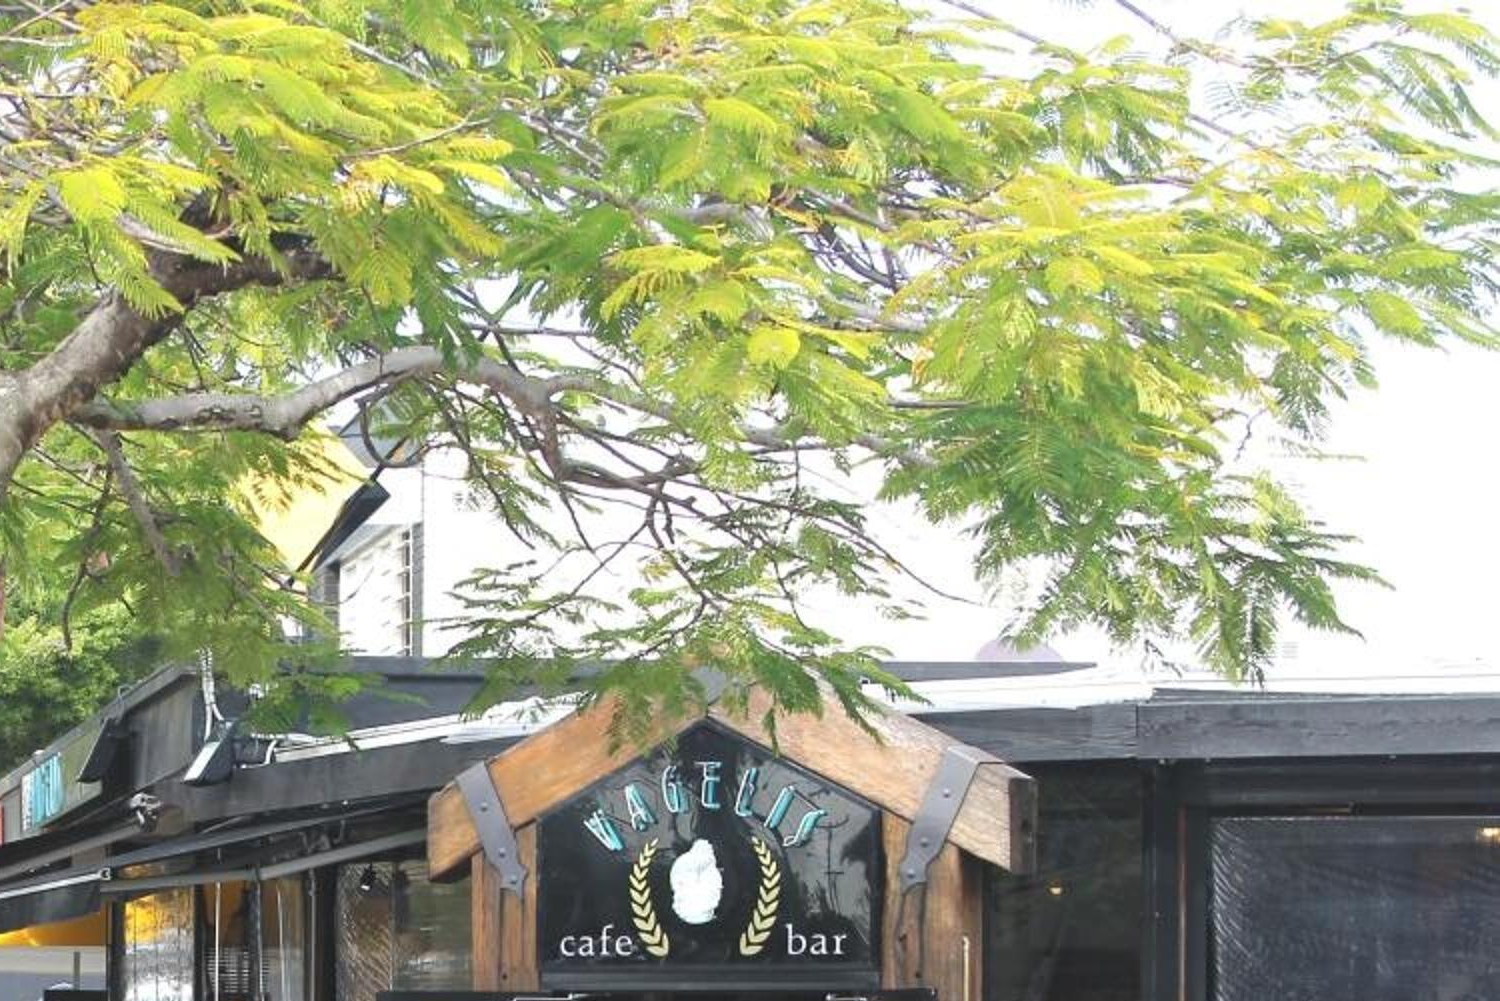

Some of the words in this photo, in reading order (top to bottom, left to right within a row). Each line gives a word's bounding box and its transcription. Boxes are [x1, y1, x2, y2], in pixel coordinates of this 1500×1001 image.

[583, 760, 829, 852] VAGELIS
[559, 924, 633, 957] cafe
[785, 922, 847, 956] bar
